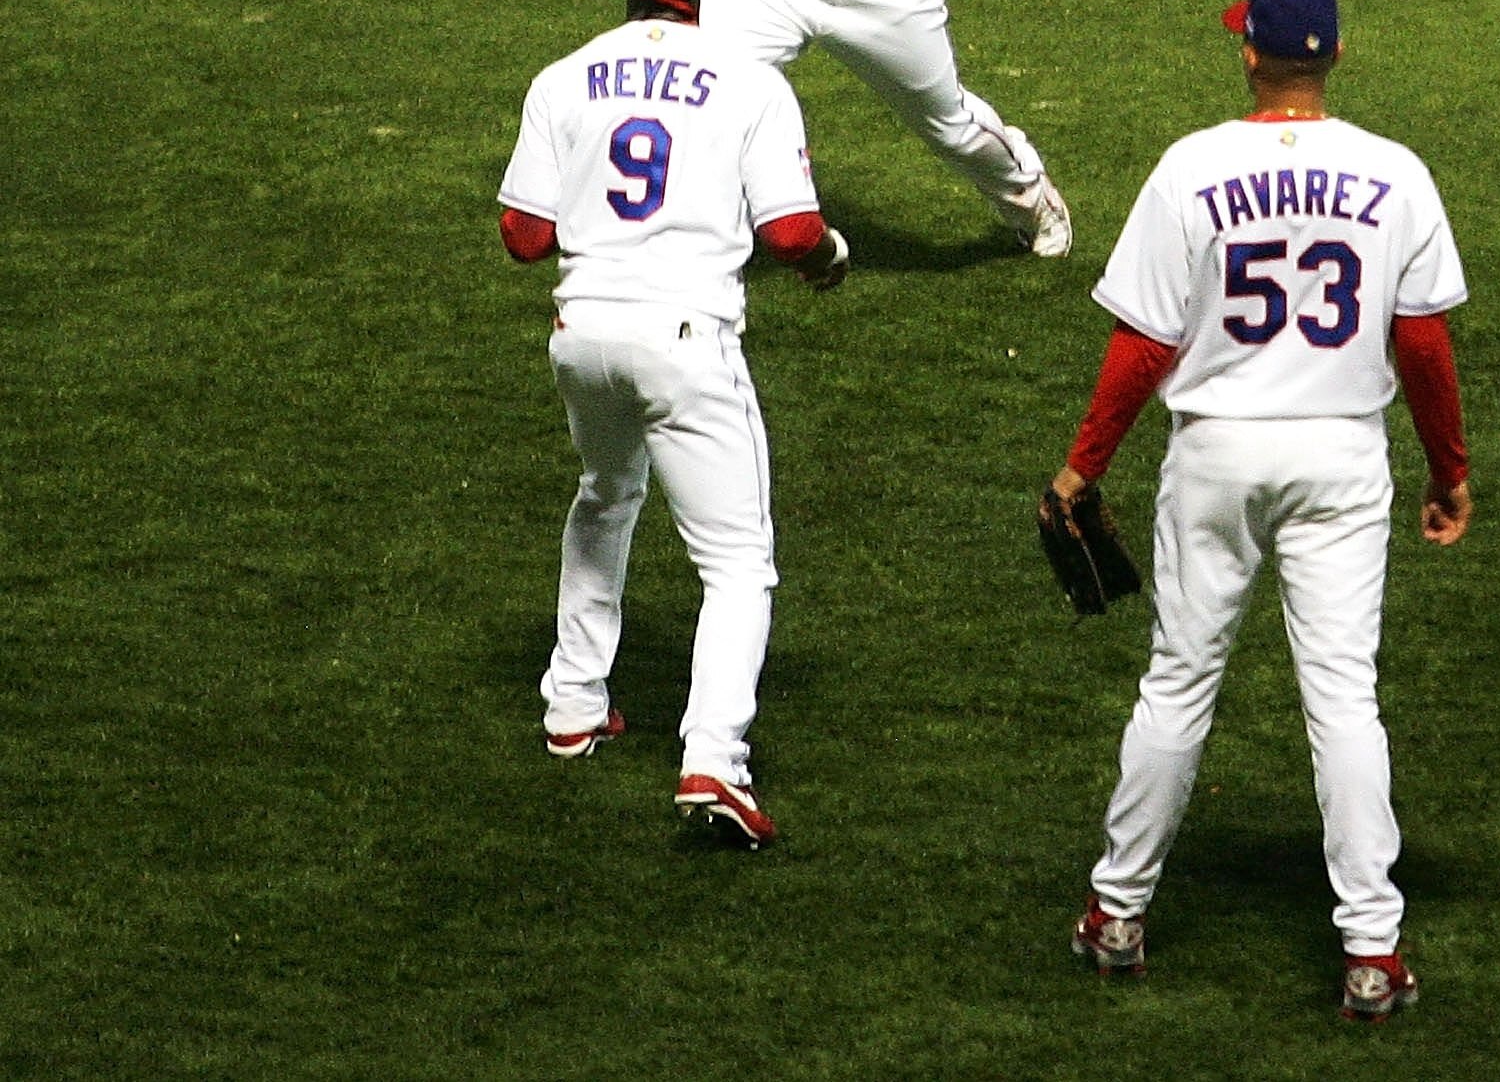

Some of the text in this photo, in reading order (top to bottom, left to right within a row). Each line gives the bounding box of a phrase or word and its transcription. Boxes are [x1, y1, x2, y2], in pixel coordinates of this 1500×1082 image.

[588, 57, 718, 107] REYES
[606, 116, 673, 222] 9
[1196, 168, 1391, 233] TAVAREZ
[1223, 238, 1362, 349] 53
